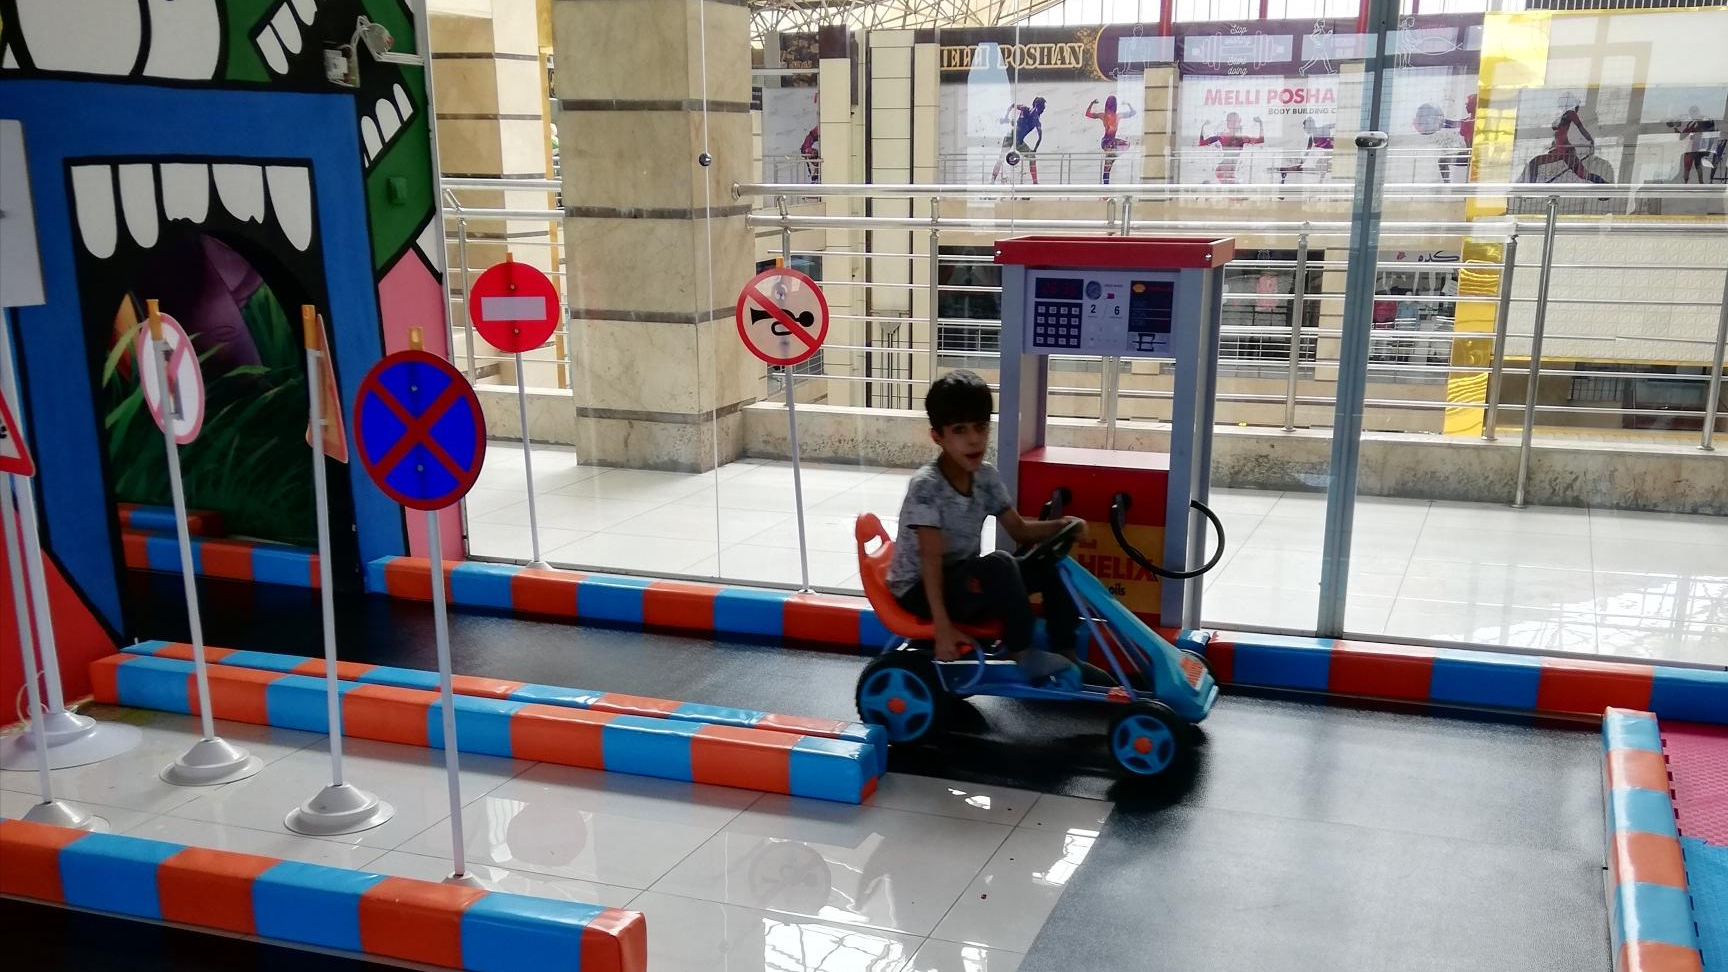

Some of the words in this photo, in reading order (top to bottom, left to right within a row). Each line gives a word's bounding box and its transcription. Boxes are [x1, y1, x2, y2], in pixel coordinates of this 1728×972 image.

[997, 44, 1084, 69] POSHAN
[1204, 88, 1261, 106] MELLI
[1266, 88, 1336, 105] POSHA
[1268, 107, 1290, 115] BODY
[1292, 107, 1329, 115] BUILDING
[1090, 304, 1096, 314] 2
[1114, 305, 1120, 315] 6
[1077, 553, 1159, 582] HELIX
[1108, 583, 1126, 596] oils
